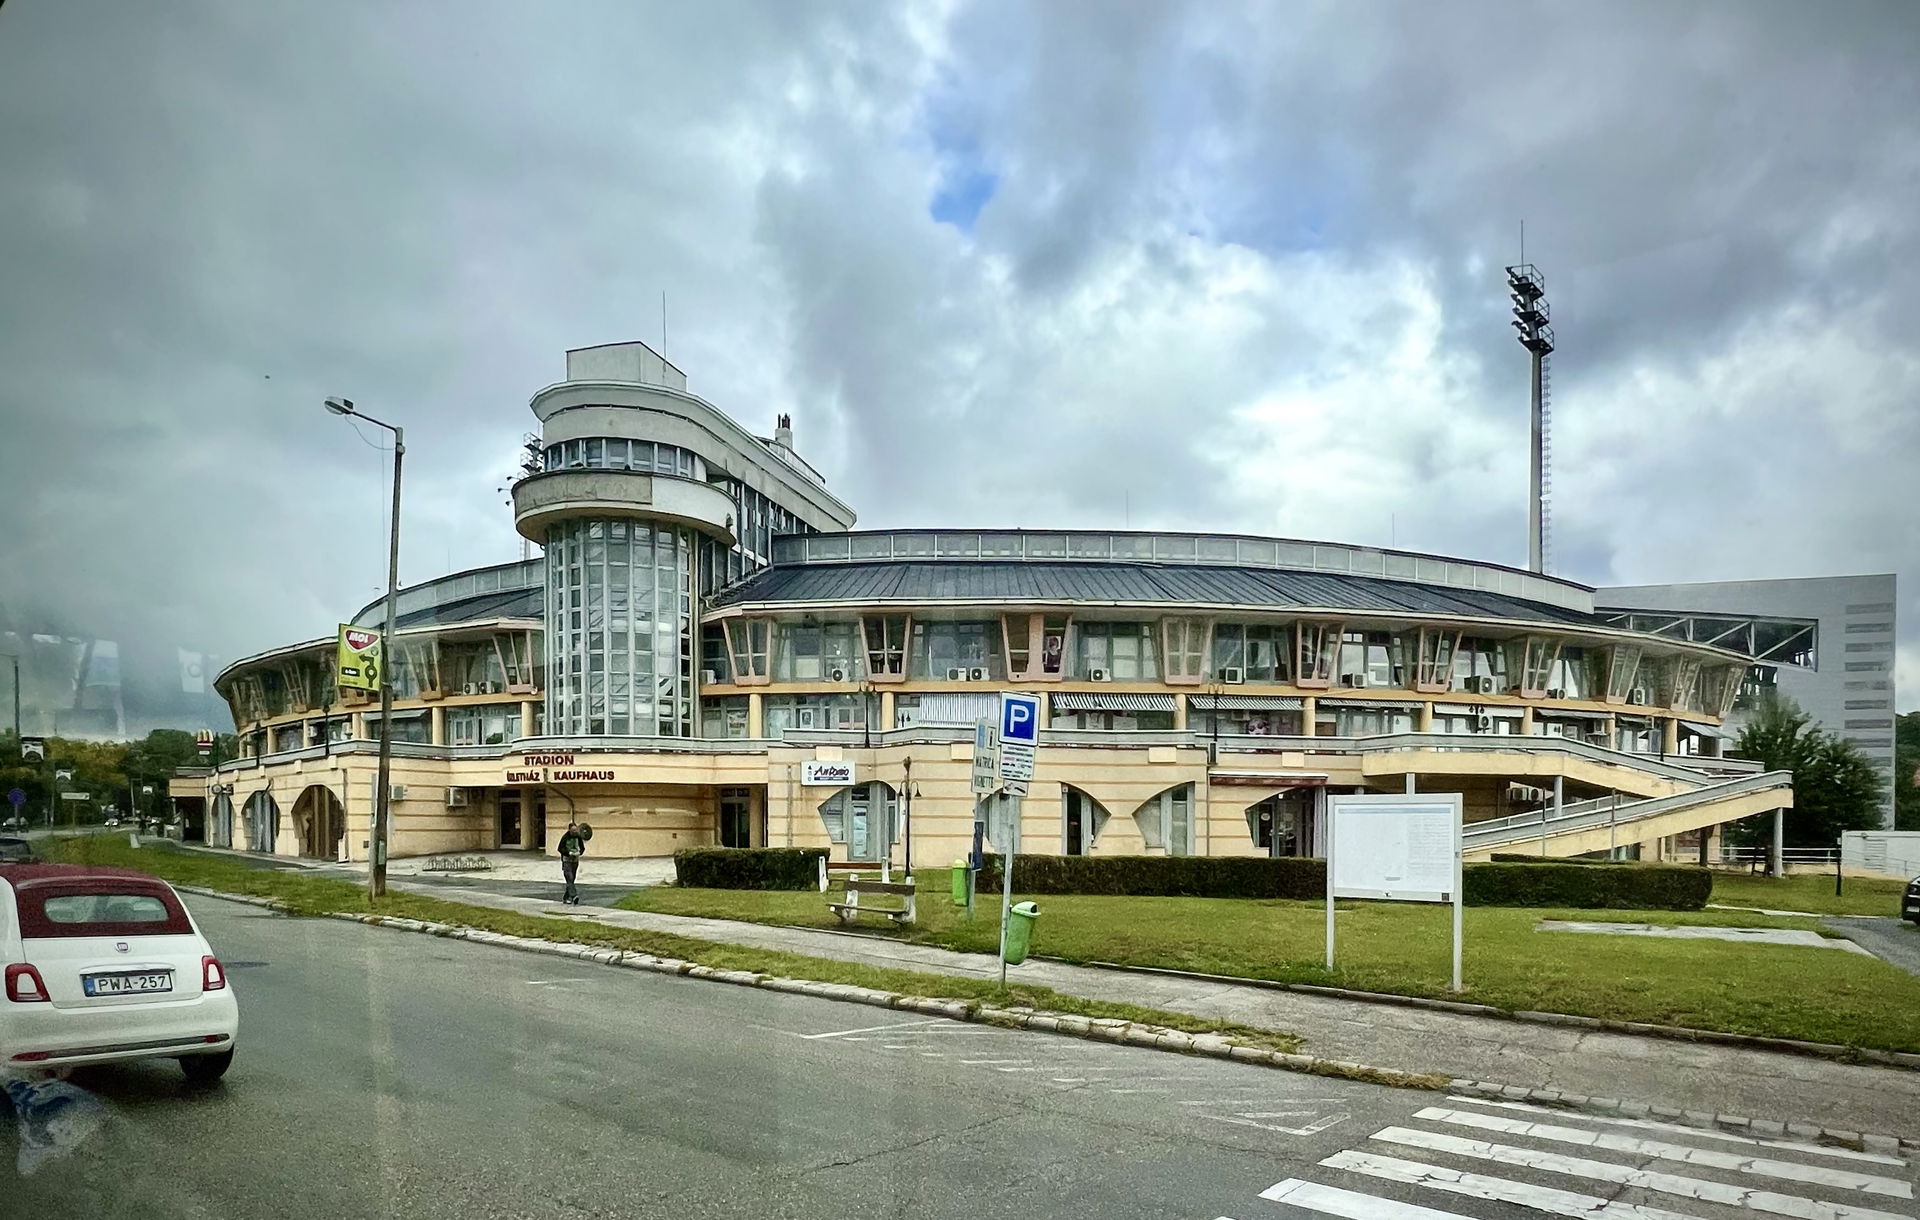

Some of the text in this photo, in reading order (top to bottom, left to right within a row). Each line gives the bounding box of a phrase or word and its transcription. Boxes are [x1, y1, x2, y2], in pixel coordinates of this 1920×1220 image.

[1009, 704, 1029, 733] P
[524, 755, 574, 766] STADION
[553, 771, 615, 781] KAUFHAUS
[98, 975, 166, 991] PWA-257
